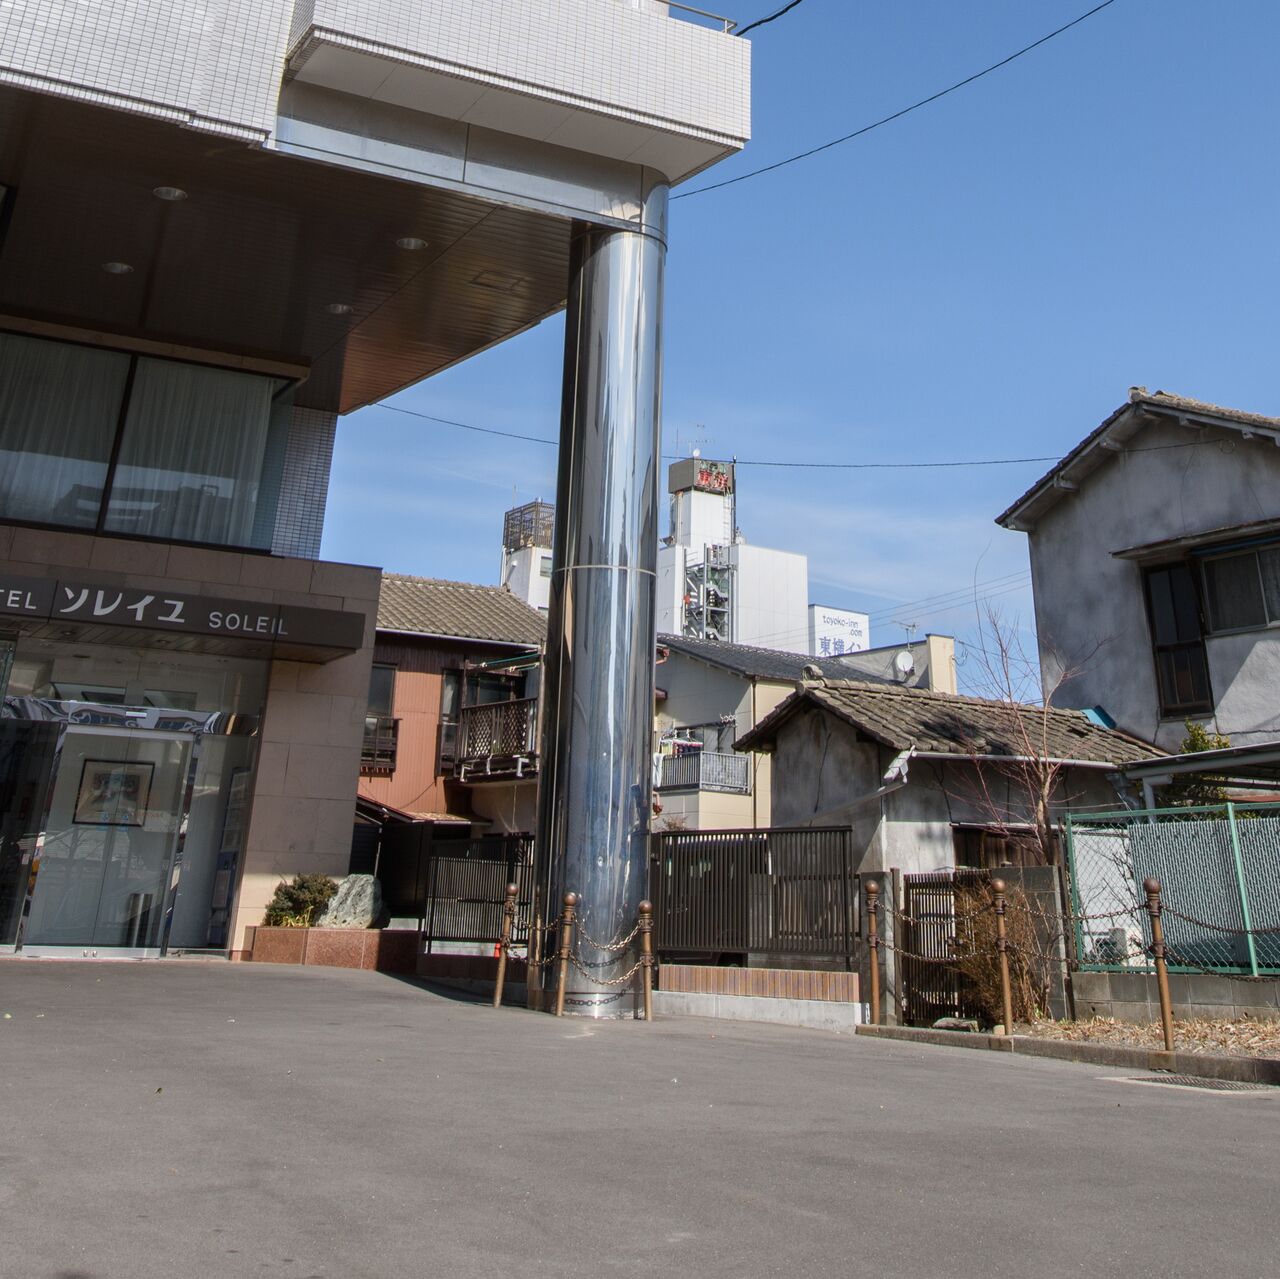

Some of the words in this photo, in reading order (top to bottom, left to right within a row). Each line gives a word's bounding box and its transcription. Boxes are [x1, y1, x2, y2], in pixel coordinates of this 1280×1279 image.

[59, 586, 185, 623] ソレイユ
[208, 610, 289, 635] SOLEIL
